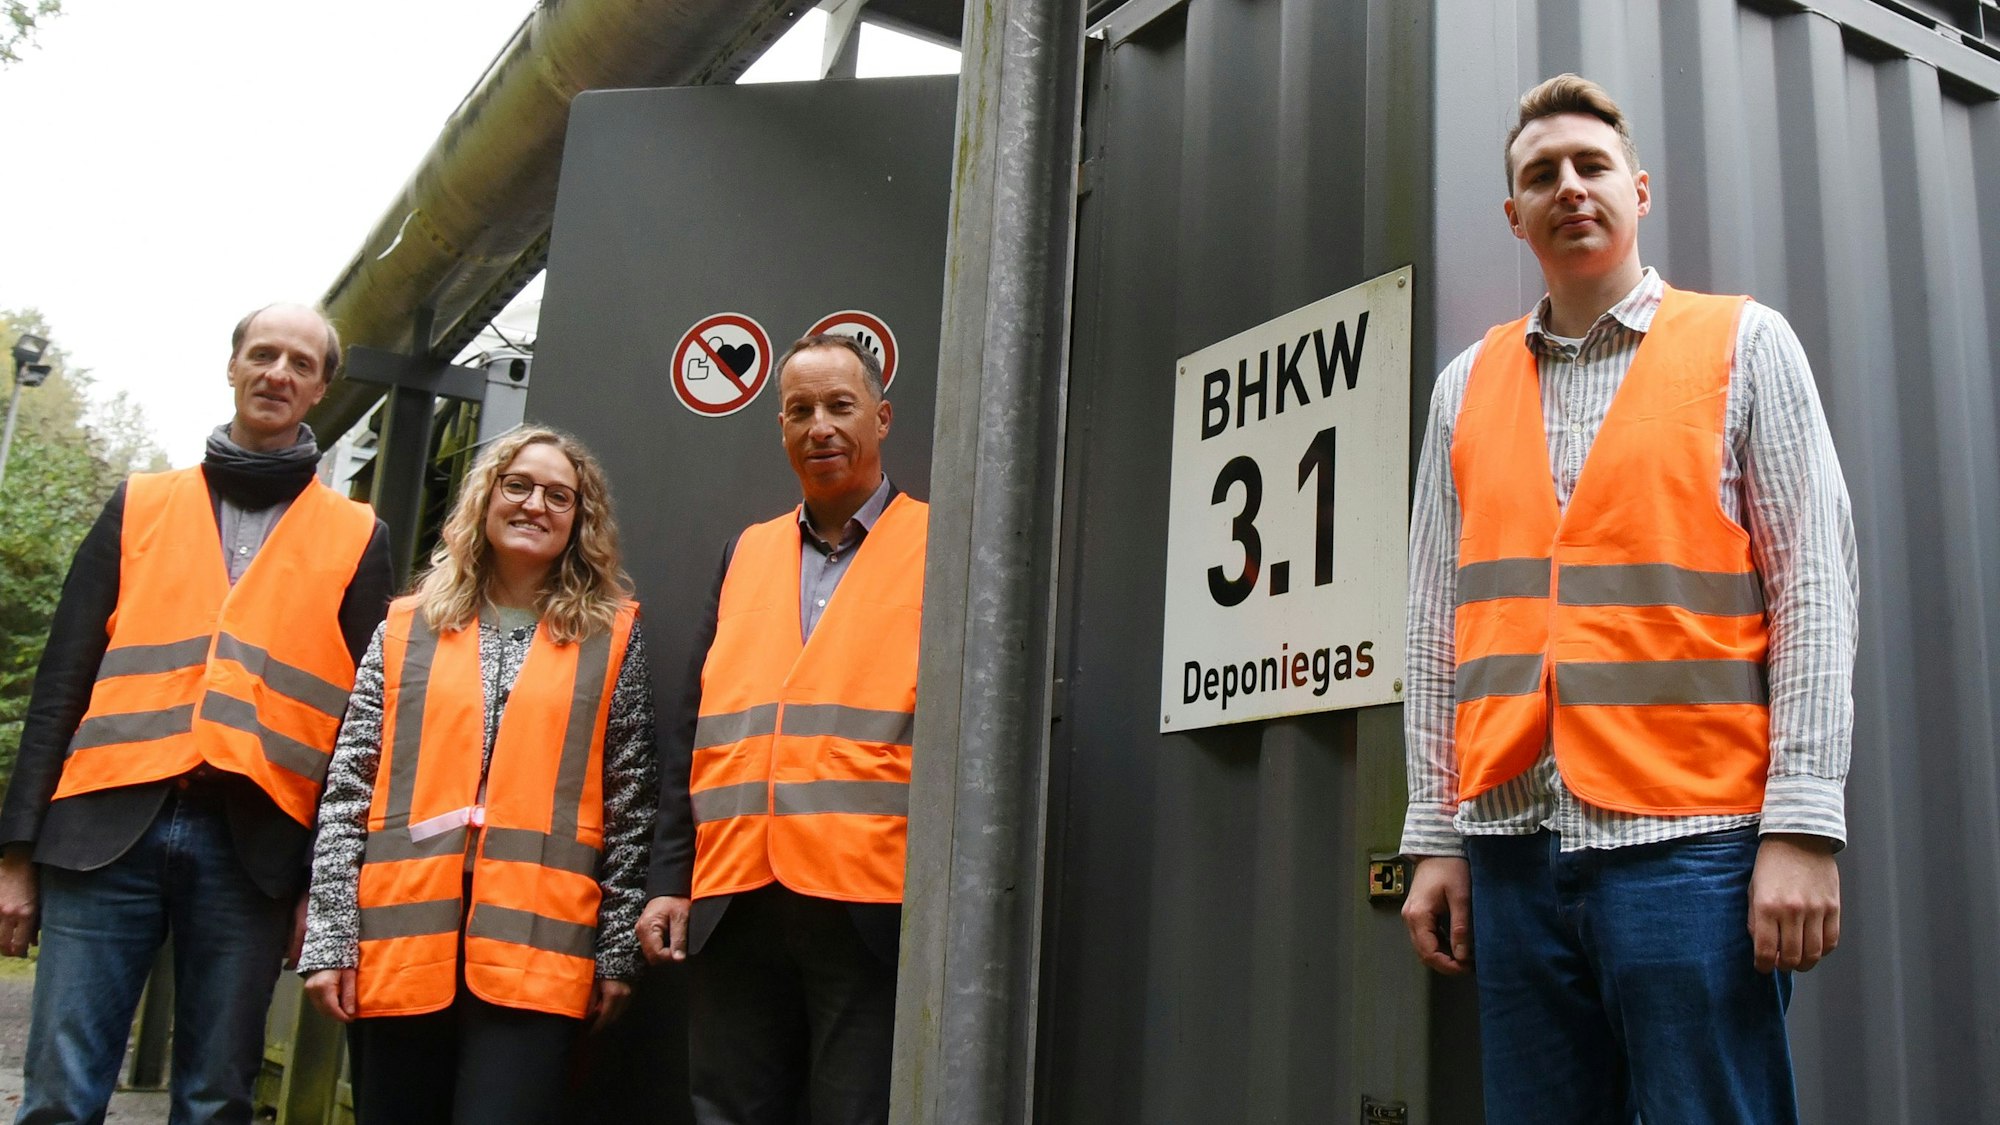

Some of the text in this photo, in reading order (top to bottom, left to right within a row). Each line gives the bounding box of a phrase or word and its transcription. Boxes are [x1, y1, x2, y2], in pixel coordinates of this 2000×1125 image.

[1201, 310, 1370, 441] BHKW
[1207, 426, 1336, 607] 3.1
[1182, 640, 1375, 710] Deponiegas
